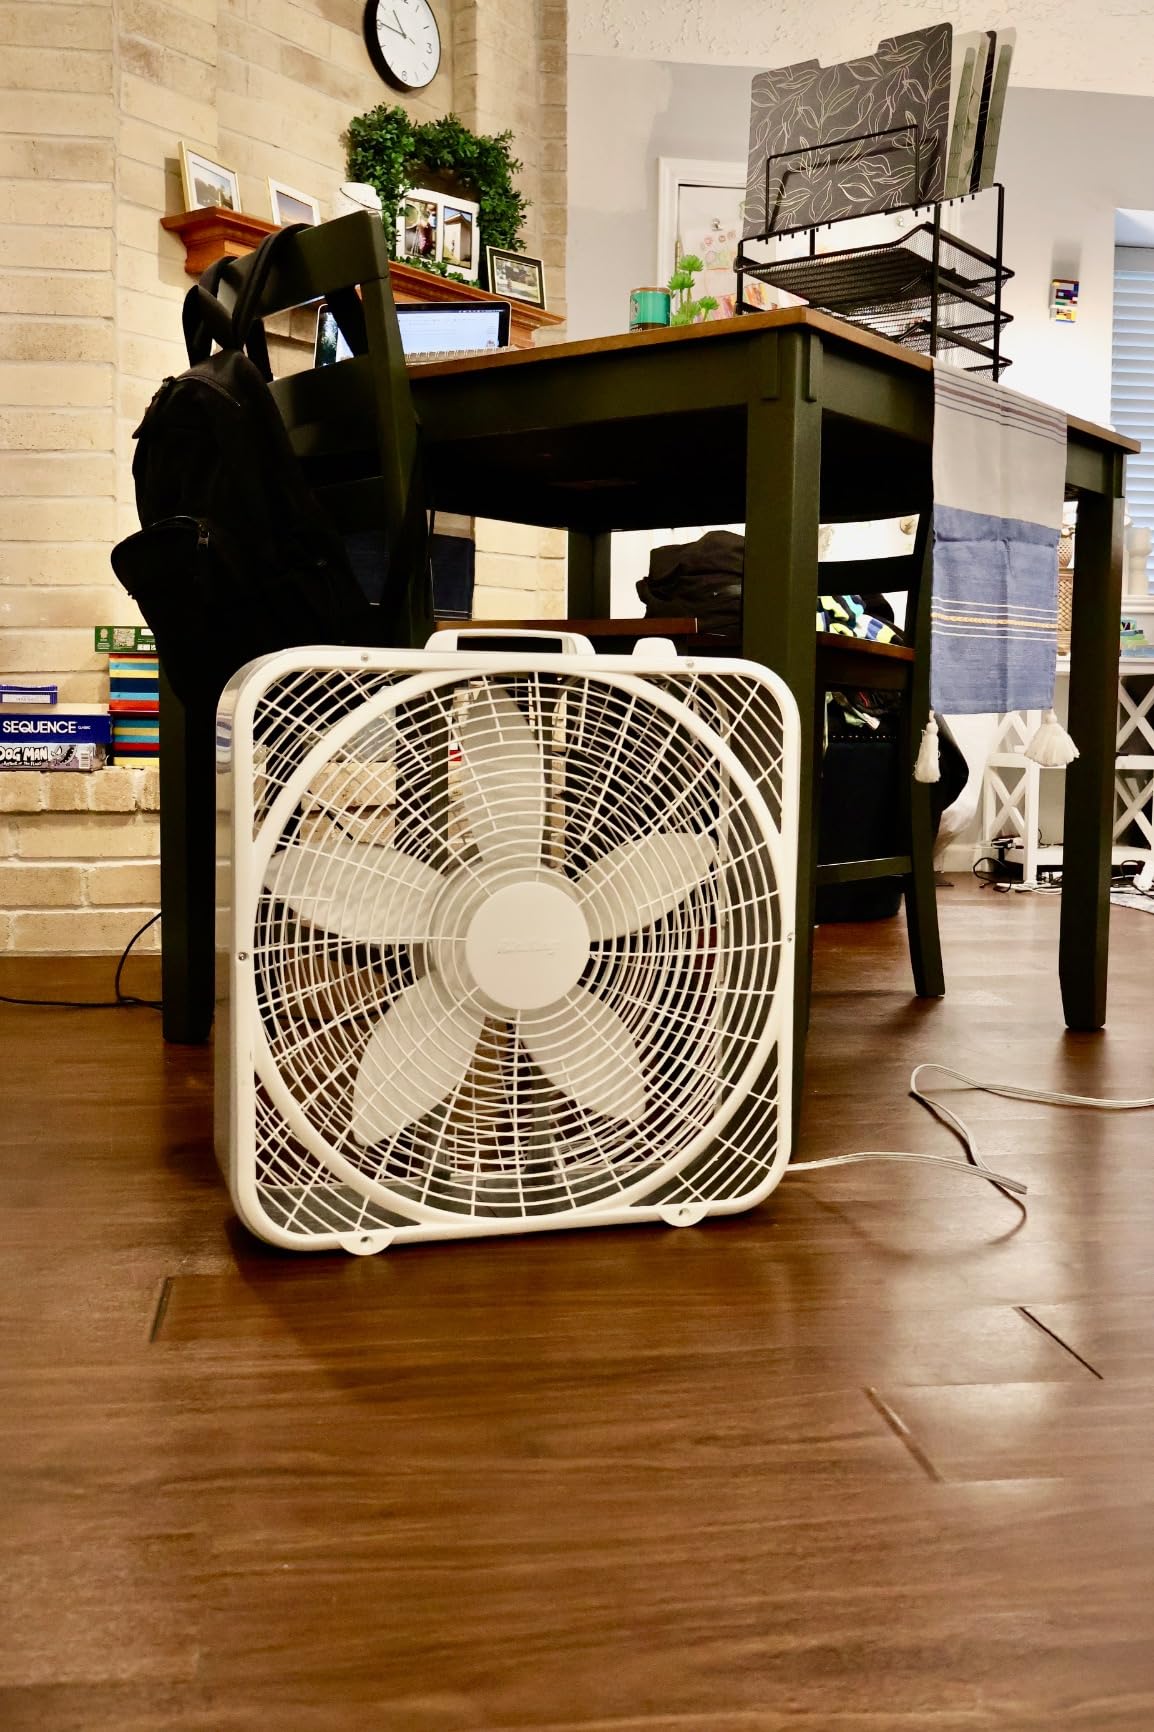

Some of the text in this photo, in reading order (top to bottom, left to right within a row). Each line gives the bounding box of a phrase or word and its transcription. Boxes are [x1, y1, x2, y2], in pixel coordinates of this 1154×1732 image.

[427, 42, 433, 54] 3
[402, 70, 407, 81] 6
[3, 720, 77, 733] SEQUENCE
[23, 746, 48, 761] MAN
